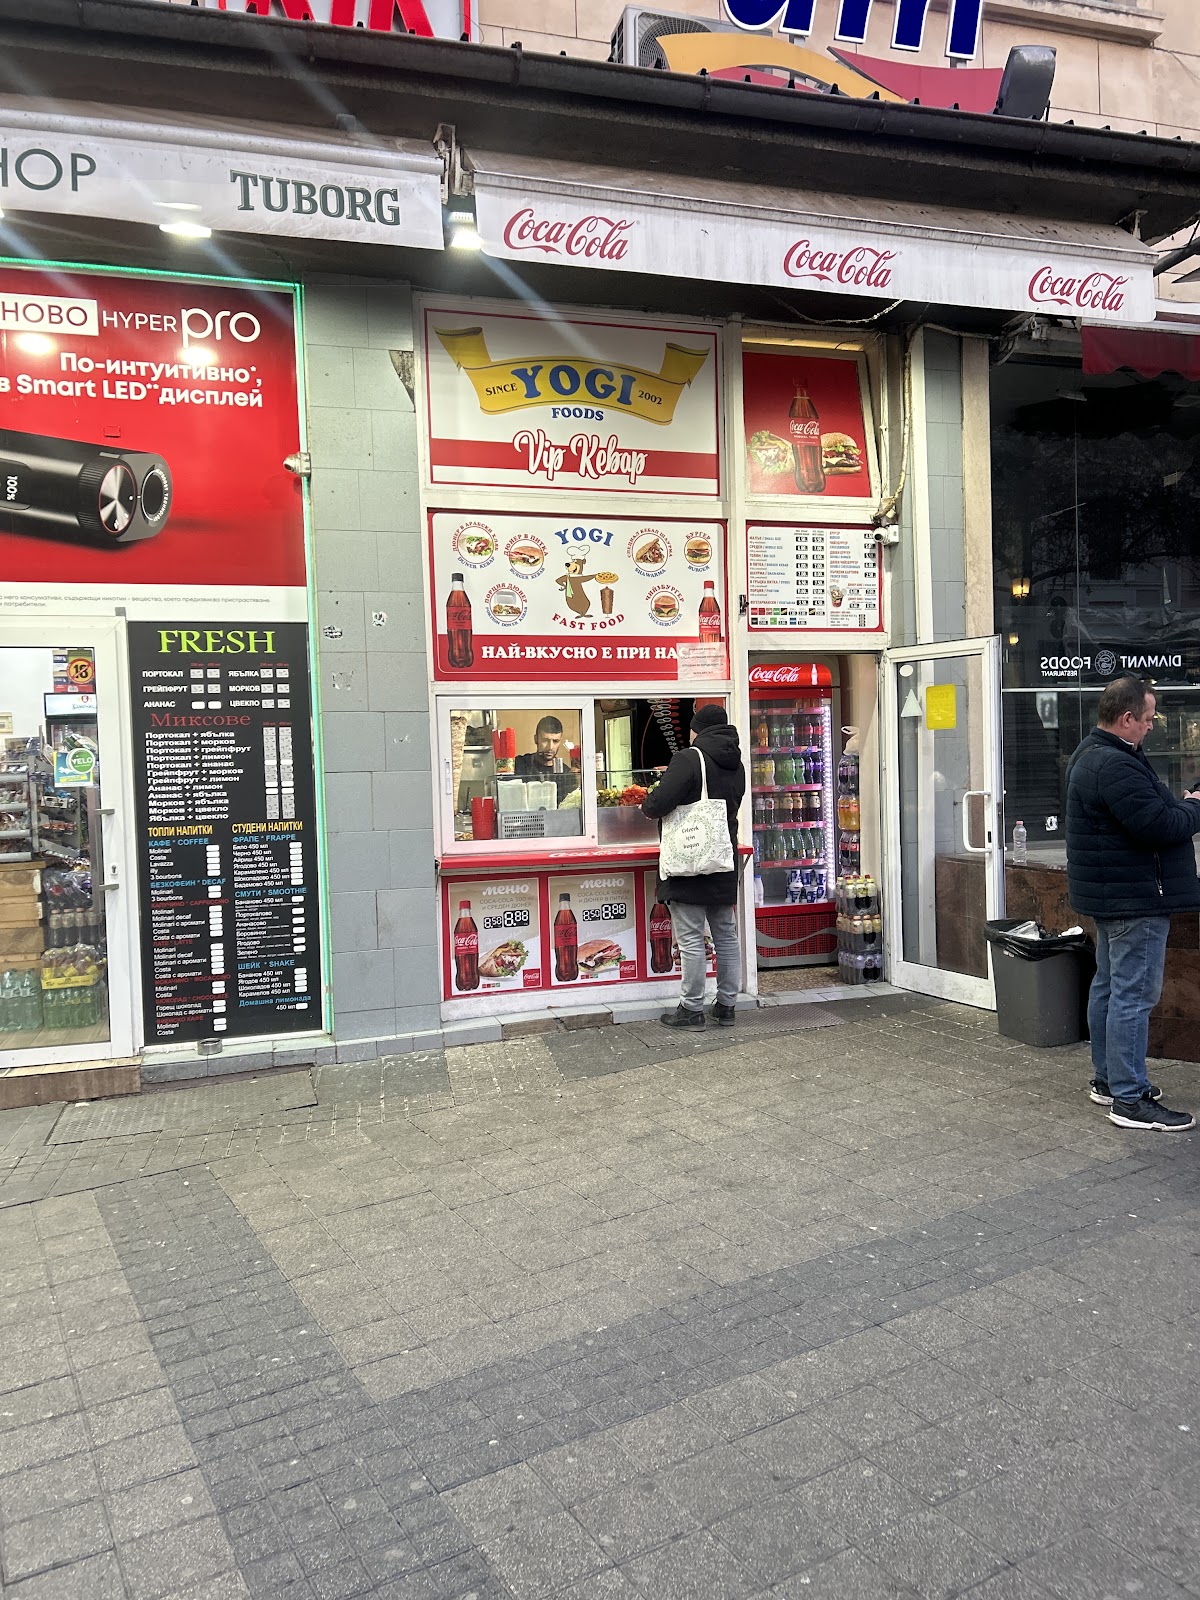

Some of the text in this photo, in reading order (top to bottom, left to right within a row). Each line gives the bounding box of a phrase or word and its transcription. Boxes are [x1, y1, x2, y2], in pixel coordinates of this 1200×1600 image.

[230, 169, 400, 226] TUBORG
[504, 208, 635, 260] Coca-Cola
[784, 240, 898, 288] Coca-Cola
[1028, 266, 1129, 311] Coca-Cola
[2, 301, 260, 348] НОВО HYPER pro
[0, 377, 10, 392] в
[16, 374, 96, 398] Smart
[159, 388, 262, 408] дисплей
[486, 364, 663, 406] SINCE YOGI 2002
[552, 408, 604, 421] FOODS
[513, 428, 648, 485] Vip Kebap
[7, 476, 18, 500] 100%
[554, 526, 614, 546] YOGI
[686, 532, 710, 540] БУРГЕР
[552, 613, 625, 630] FAST FOOD
[157, 630, 276, 654] FRESH
[482, 642, 598, 659] НАЙ-ВКУСНО
[602, 647, 612, 659] Е
[616, 647, 650, 659] ПРИ
[74, 664, 88, 678] 18
[749, 666, 801, 682] Coca-Cola
[143, 684, 188, 692] ГРЕЙПФРУТ
[150, 713, 251, 727] Миксове
[148, 777, 200, 785] Грейпфрут
[148, 825, 212, 837] ТОПЛИ НАПИТКИ
[232, 821, 303, 834] СТУДЕНИ НАПИТКИ
[150, 880, 196, 888] БЕЗКОФЕИН
[268, 887, 307, 896] SMOOTHIE
[238, 960, 295, 970] ШЕЙК SHAKE
